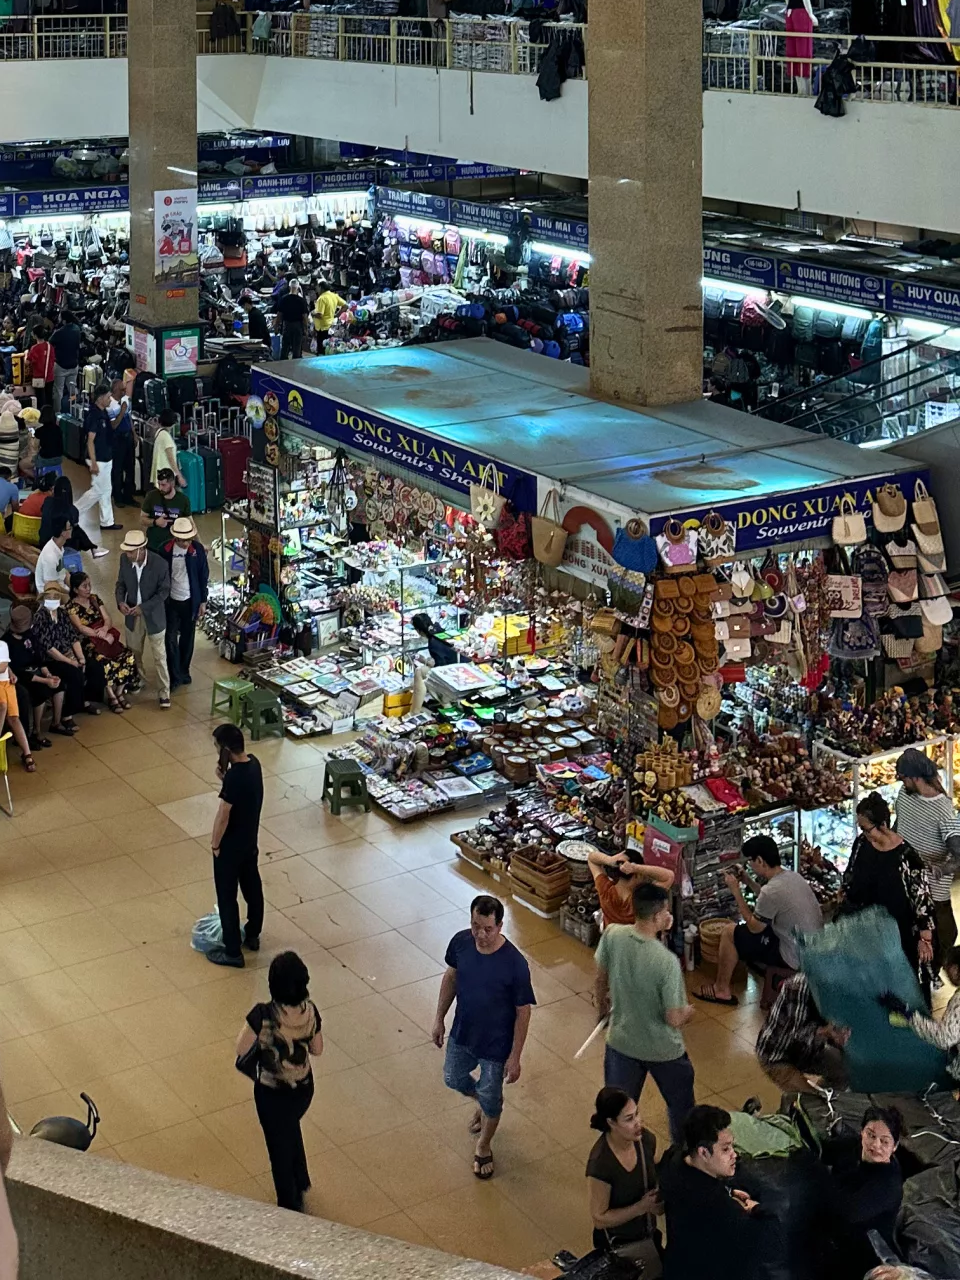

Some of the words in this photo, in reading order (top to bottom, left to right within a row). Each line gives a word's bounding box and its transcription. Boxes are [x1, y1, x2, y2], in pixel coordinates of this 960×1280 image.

[43, 192, 79, 203] HOA
[84, 189, 121, 200] NGA
[556, 222, 571, 233] MAI
[798, 267, 827, 282] QUANG
[830, 272, 861, 288] HƯƠNG
[908, 286, 932, 300] HUY
[934, 290, 960, 307] QUA
[336, 408, 391, 442] DONG
[397, 432, 457, 469] XUAN
[462, 459, 508, 488] ART
[353, 433, 434, 472] Souvenirs
[439, 468, 478, 488] Sho
[737, 502, 797, 529] DONG
[803, 490, 857, 516] XUAN
[756, 517, 832, 539] Souvenir
[591, 563, 609, 578] XUA
